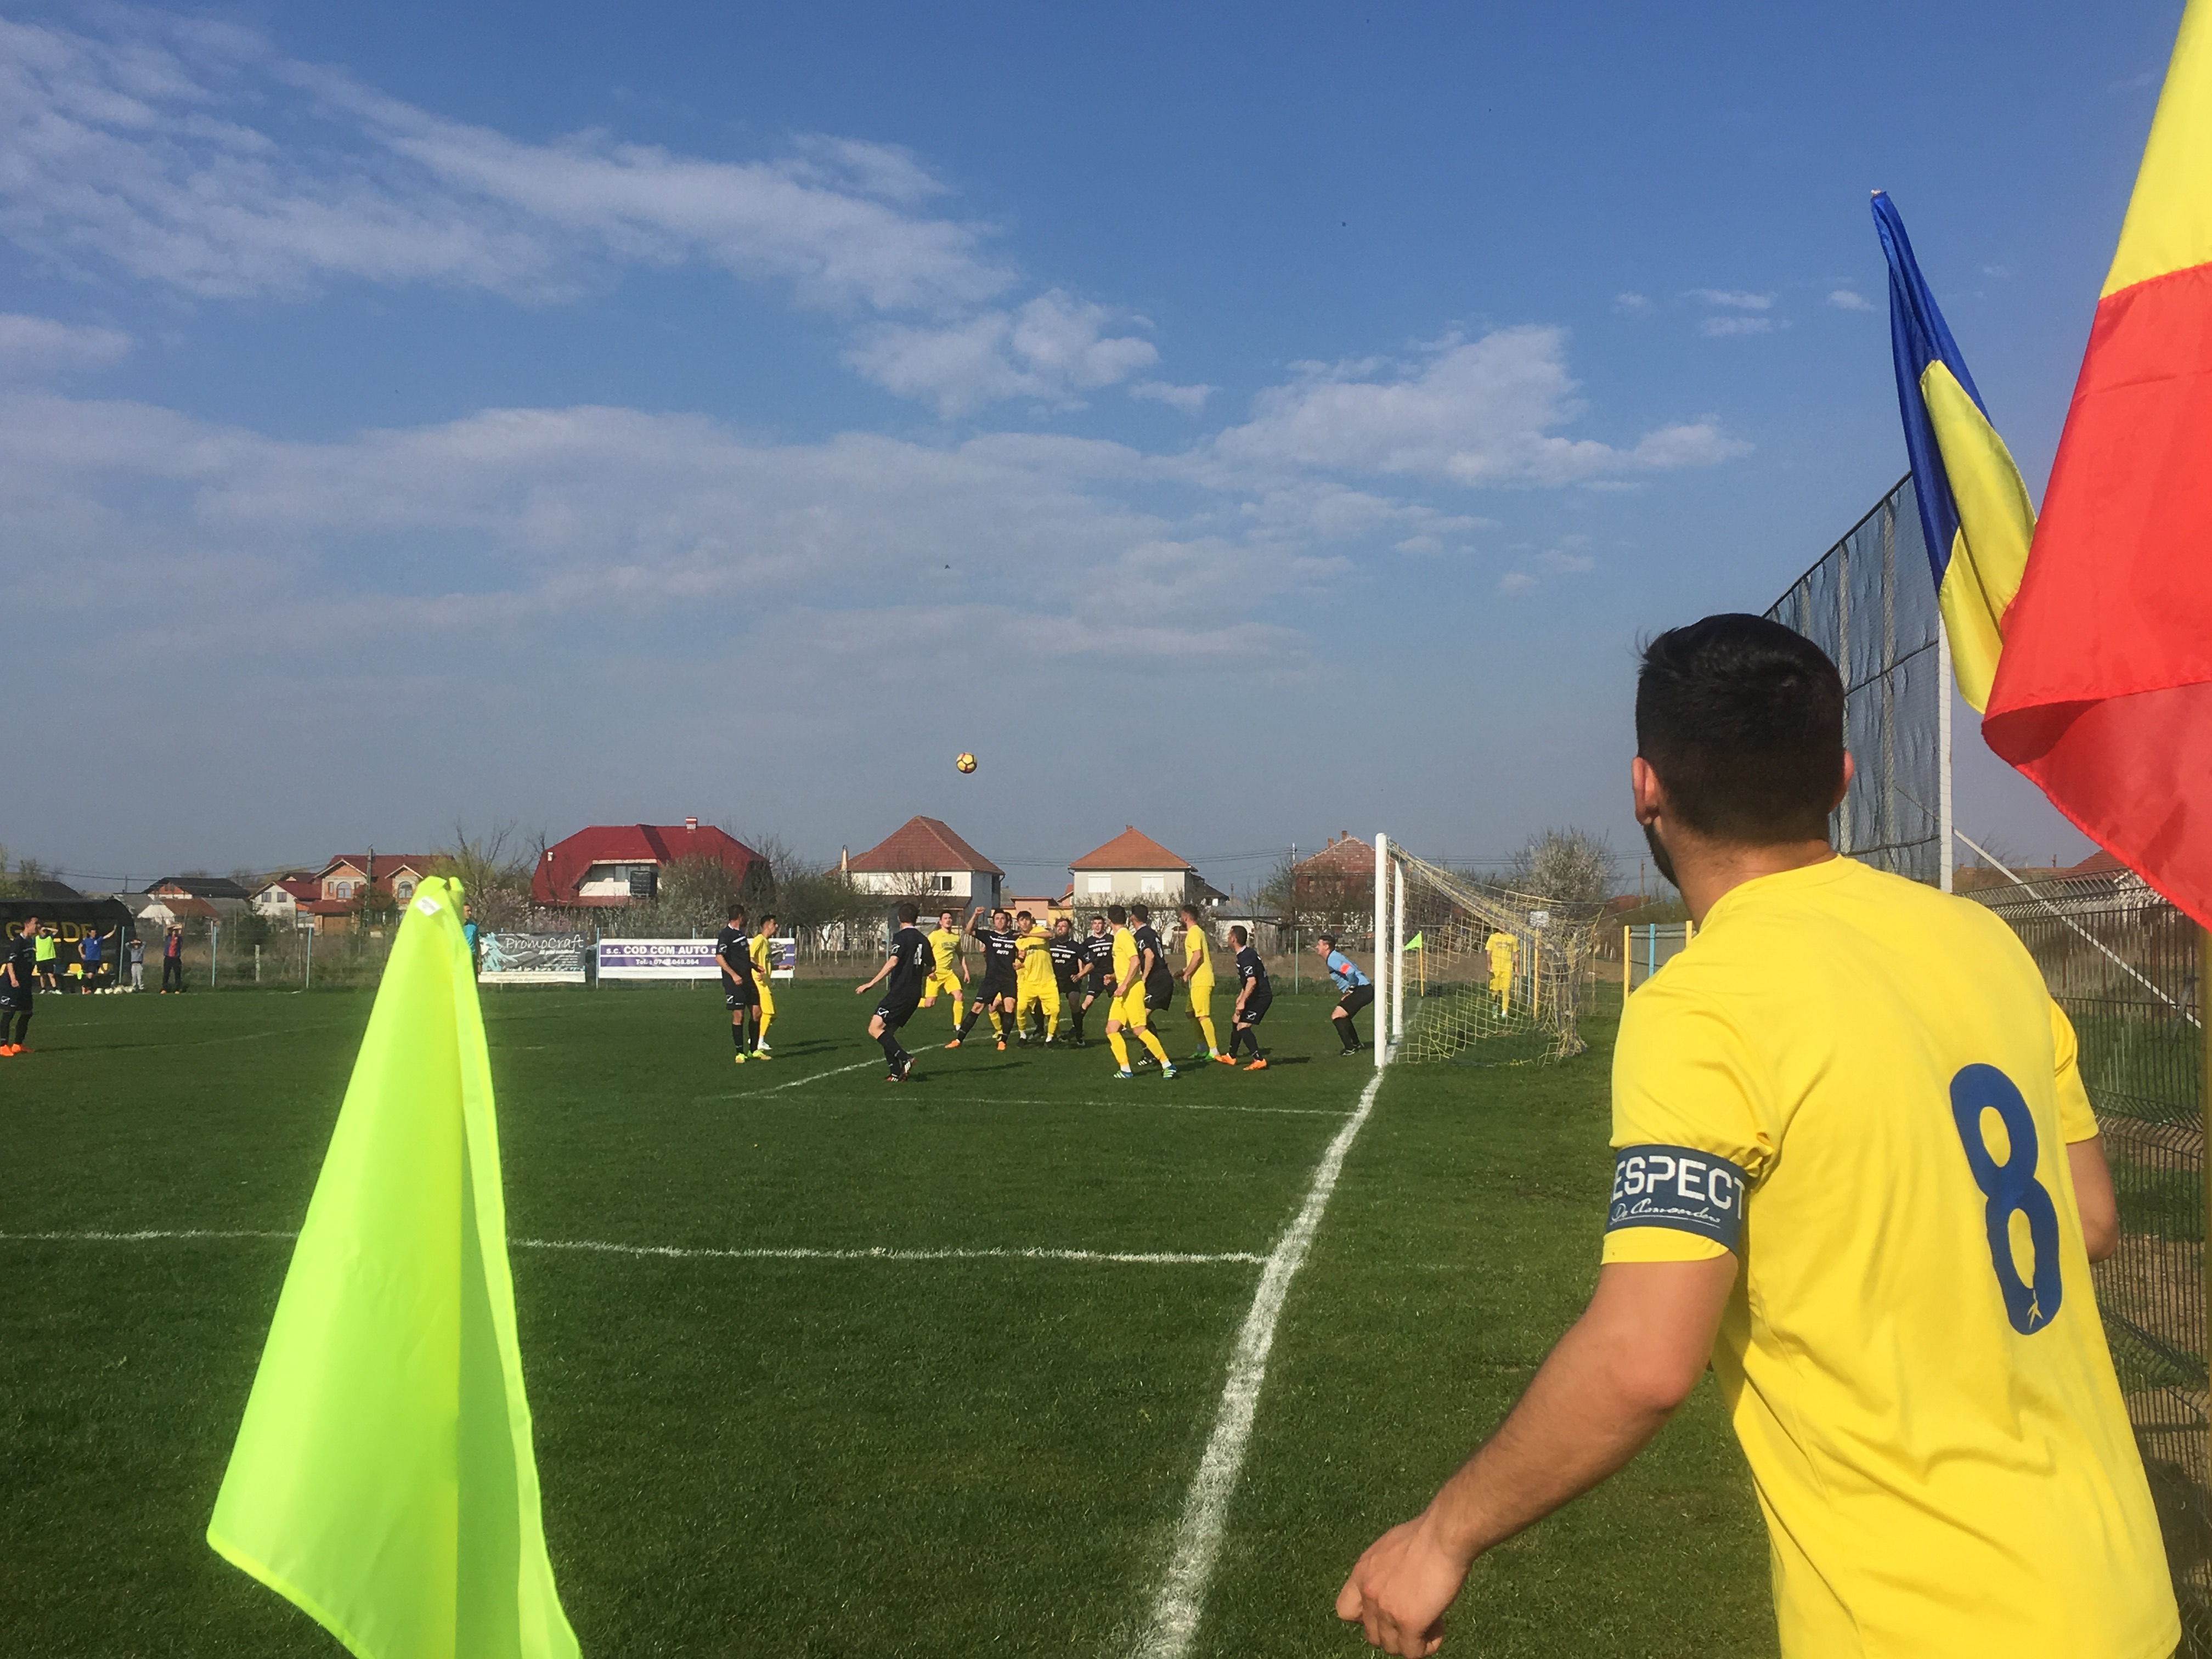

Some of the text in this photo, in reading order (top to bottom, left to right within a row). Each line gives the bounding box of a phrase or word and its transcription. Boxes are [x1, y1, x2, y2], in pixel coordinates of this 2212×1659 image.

[505, 934, 584, 950] PromoCraft
[623, 946, 647, 955] COD
[650, 946, 675, 955] COM
[678, 946, 709, 955] AUTO
[1610, 1155, 1745, 1220] ESPECT
[1949, 1063, 2063, 1336] 8
